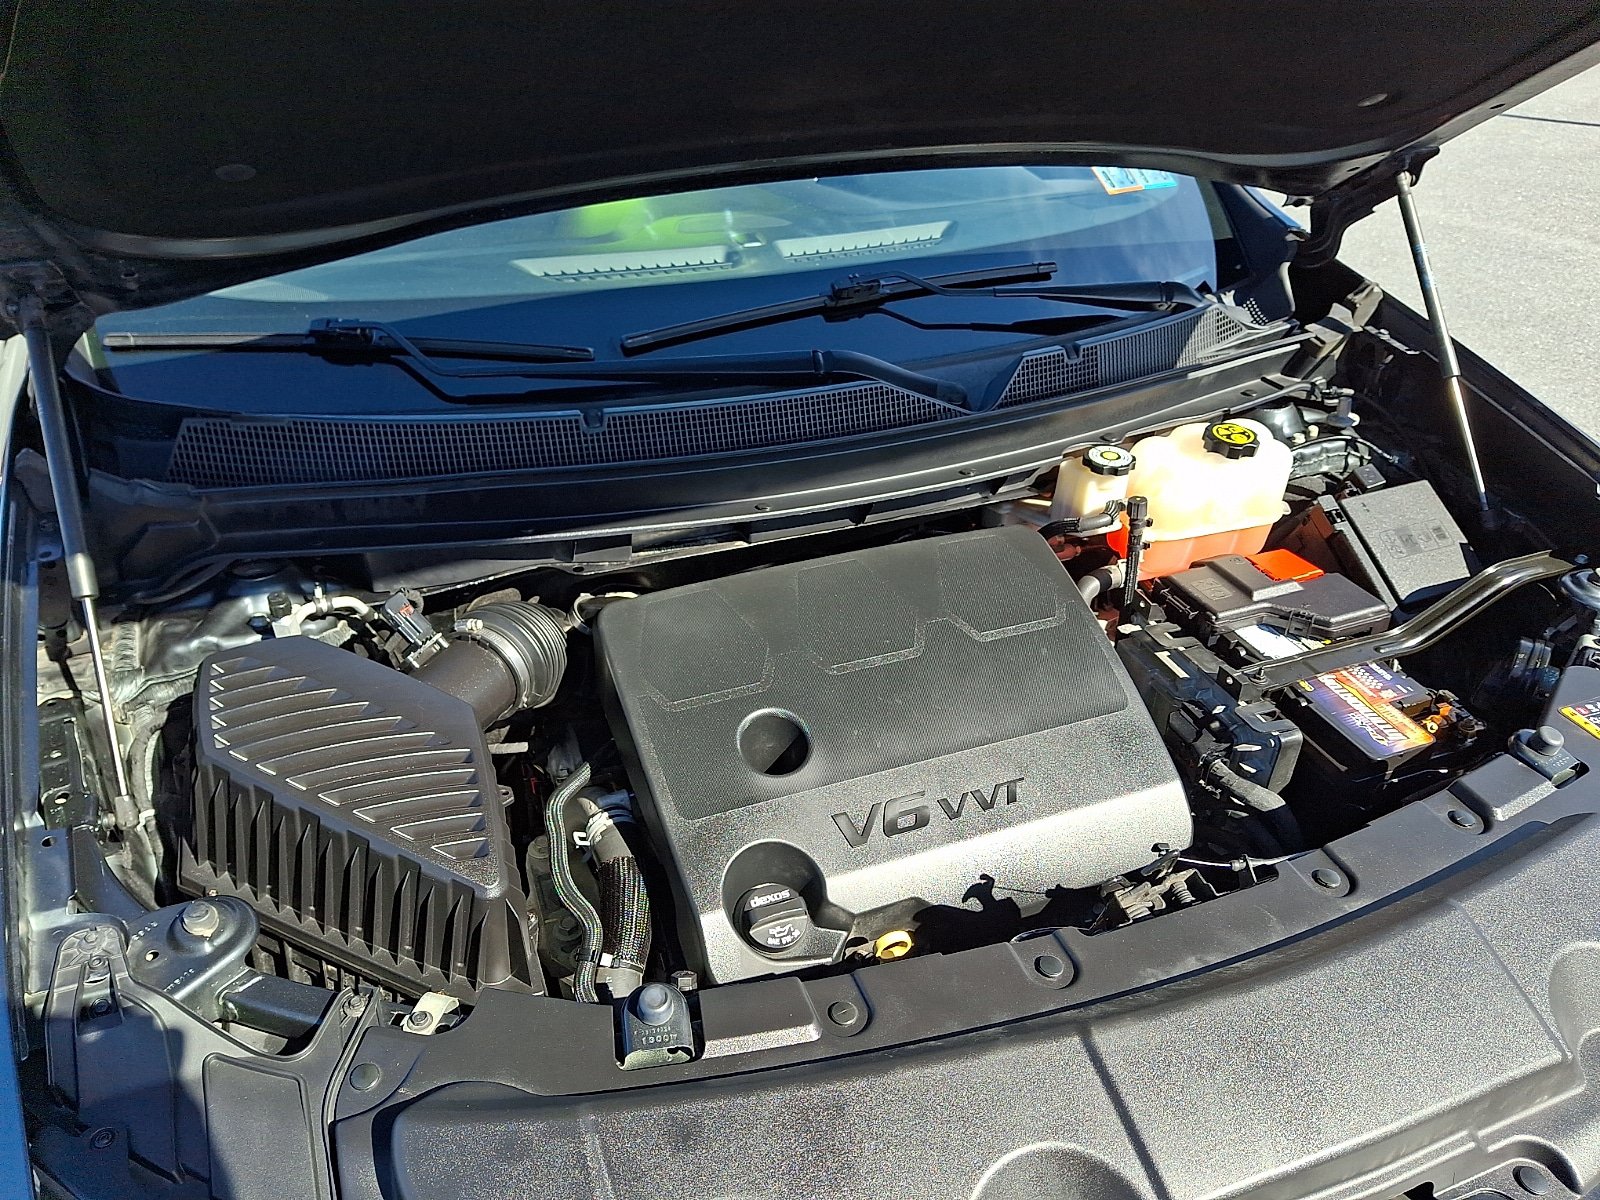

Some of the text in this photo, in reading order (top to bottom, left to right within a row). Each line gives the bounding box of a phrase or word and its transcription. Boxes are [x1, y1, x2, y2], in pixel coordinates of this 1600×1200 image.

[831, 777, 1025, 849] V6 VVT
[750, 889, 790, 908] dexos
